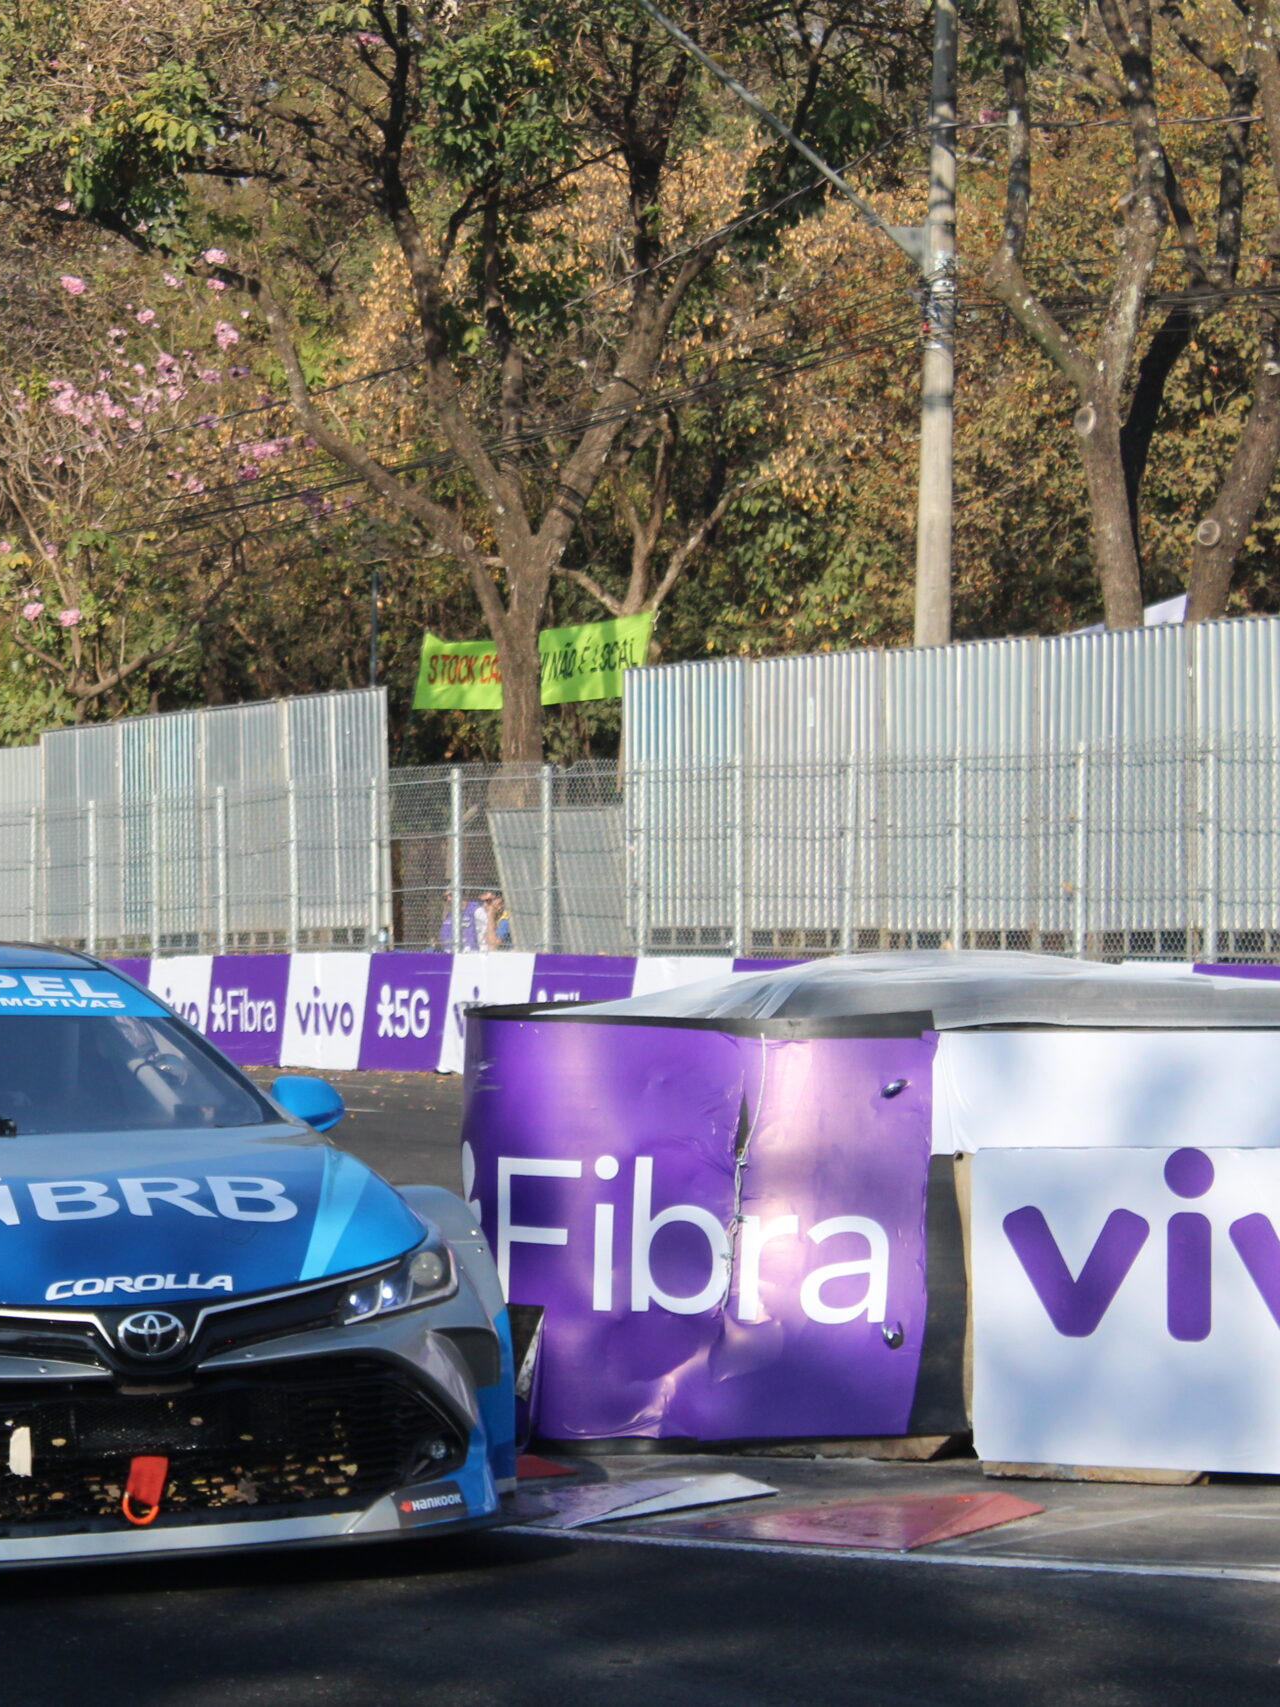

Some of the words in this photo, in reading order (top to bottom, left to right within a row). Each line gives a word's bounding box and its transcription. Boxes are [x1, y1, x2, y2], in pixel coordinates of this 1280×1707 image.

[428, 654, 478, 685] STOCK
[227, 988, 276, 1032] Fibra
[295, 985, 354, 1037] vivo
[394, 988, 431, 1038] 5G
[28, 1176, 298, 1222] BRB
[497, 1155, 890, 1324] Fibra
[45, 1274, 233, 1300] COROLLA
